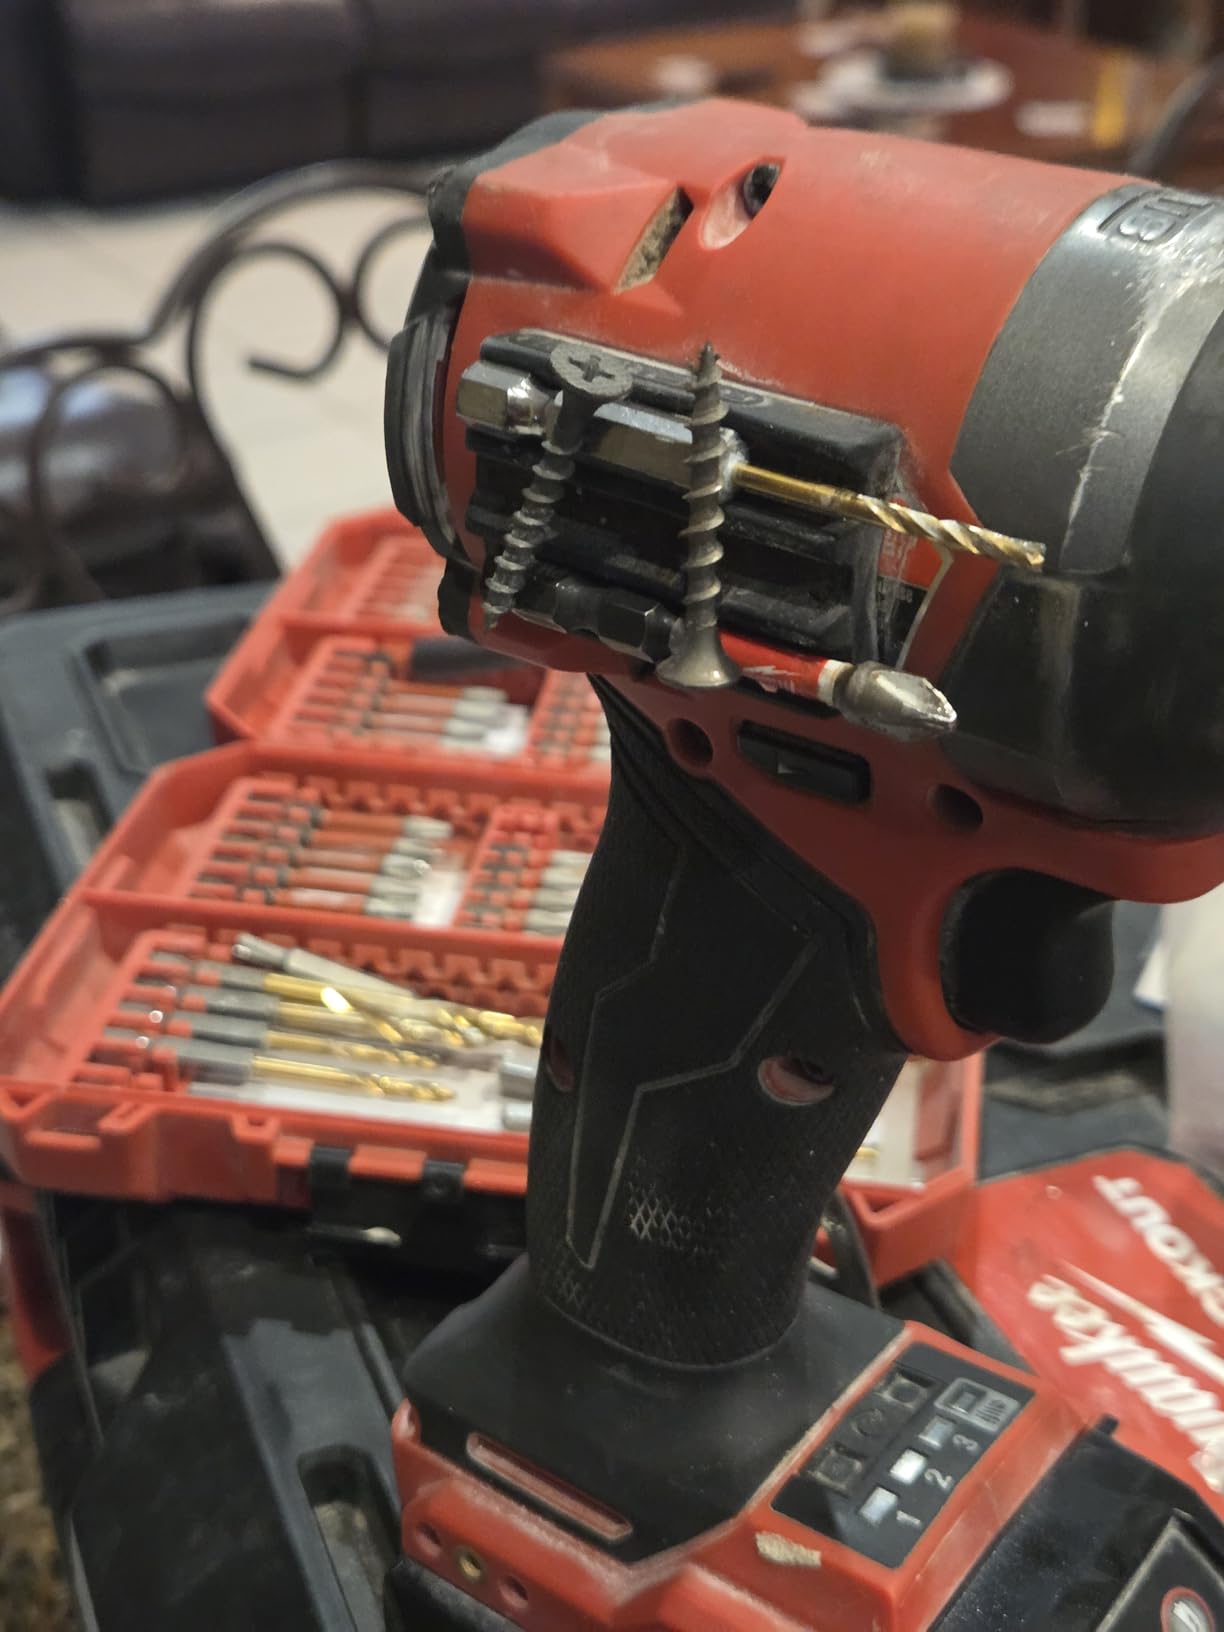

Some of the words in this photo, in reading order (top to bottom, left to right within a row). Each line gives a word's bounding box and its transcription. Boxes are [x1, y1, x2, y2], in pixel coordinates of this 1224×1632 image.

[896, 1510, 921, 1525] 1
[924, 1468, 953, 1490] 2
[953, 1434, 979, 1453] 3
